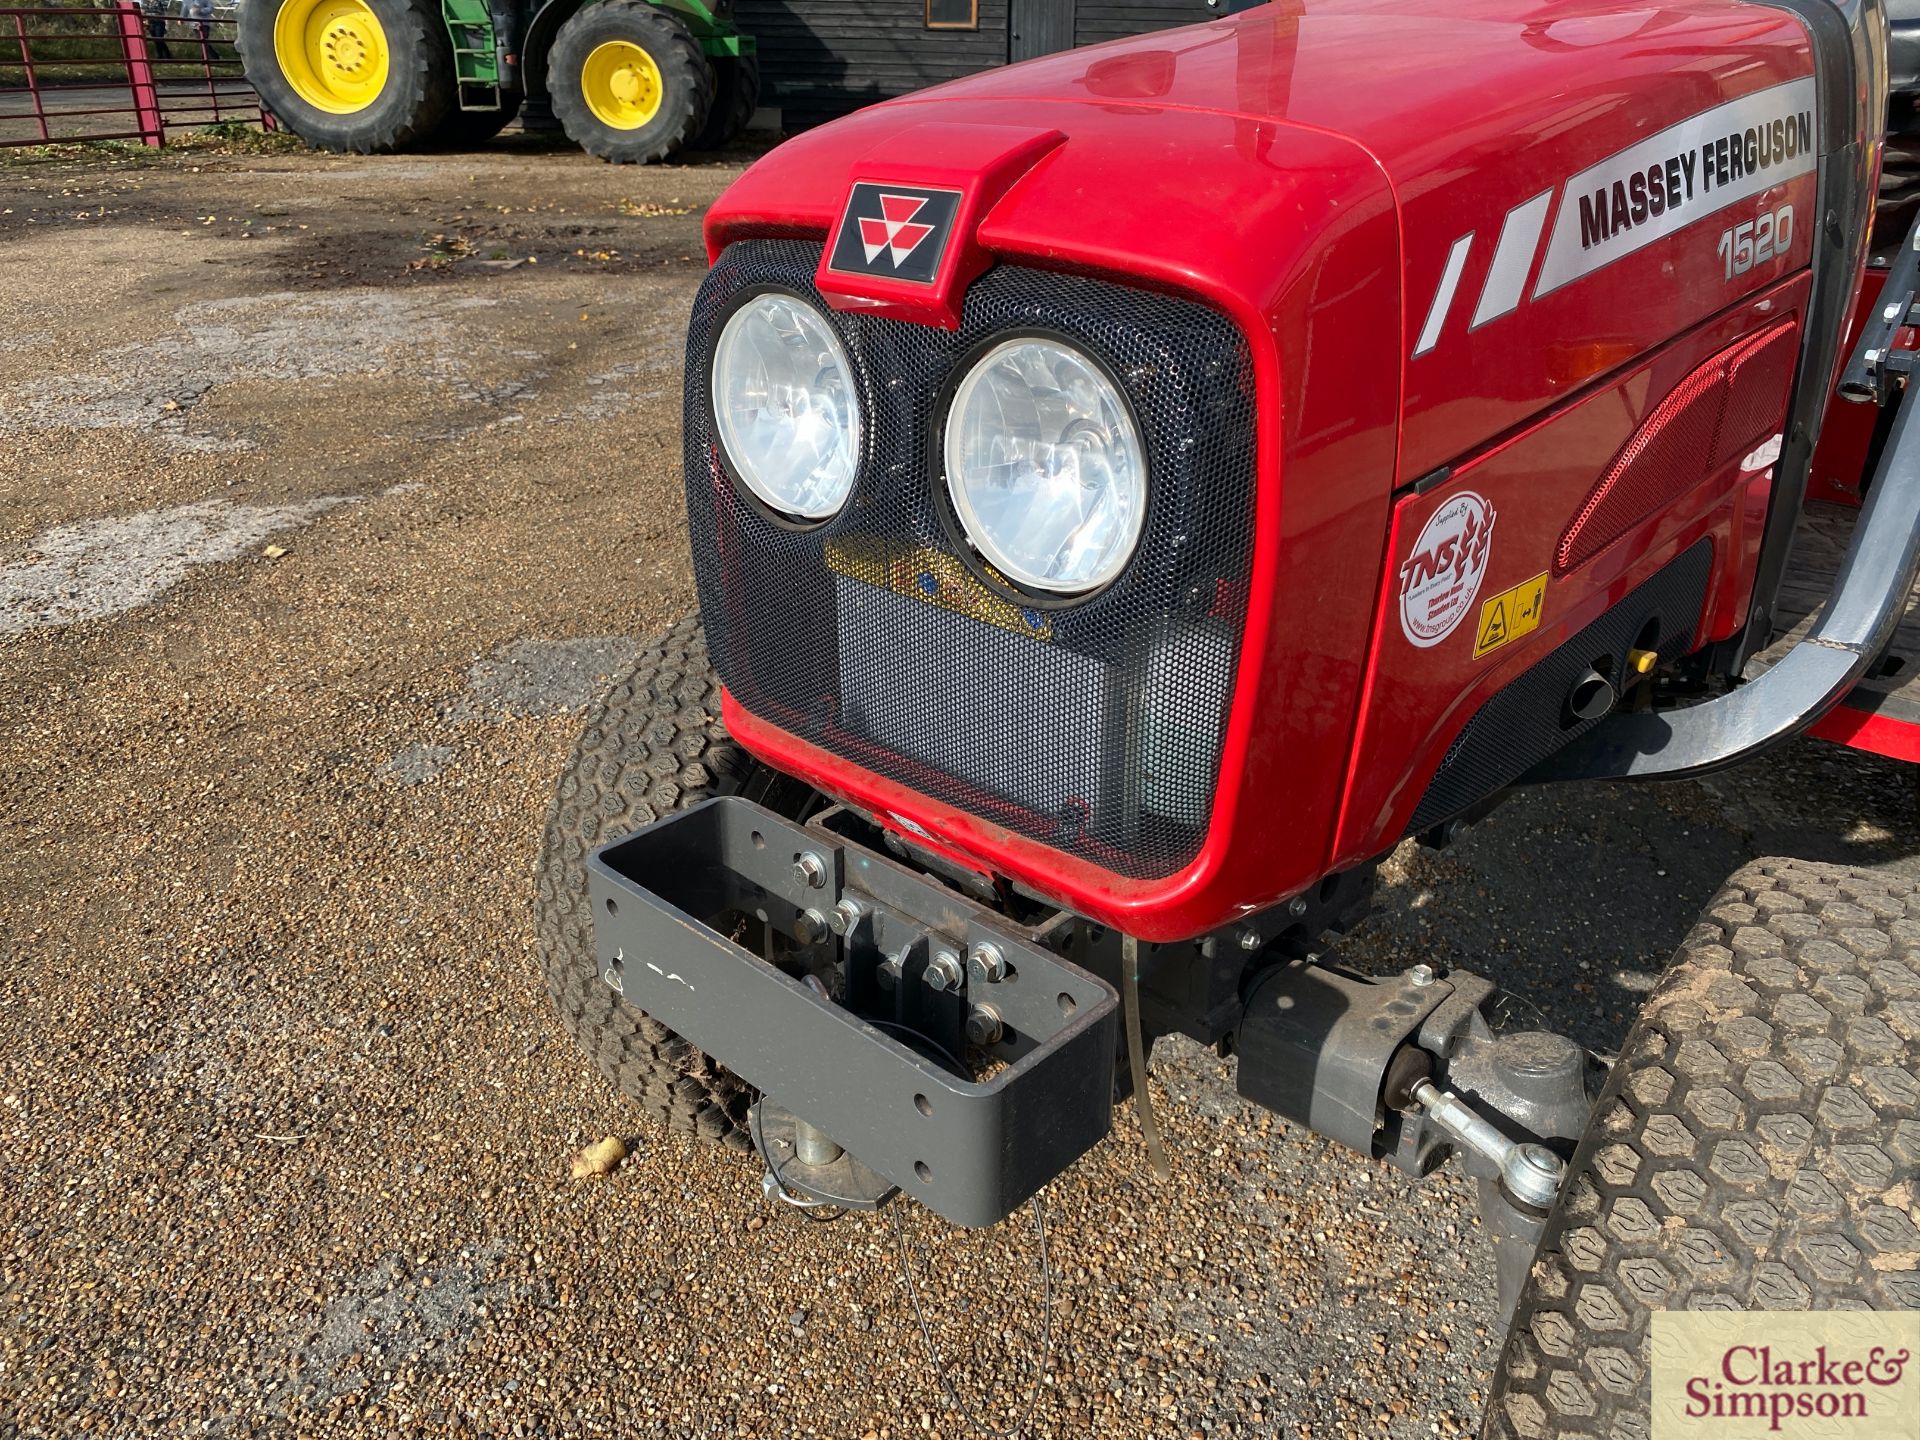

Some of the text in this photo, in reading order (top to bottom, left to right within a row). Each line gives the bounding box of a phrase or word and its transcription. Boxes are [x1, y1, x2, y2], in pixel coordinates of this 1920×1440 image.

[1579, 110, 1811, 250] MASSEY FERGUSON
[1716, 204, 1794, 281] 1520
[1436, 502, 1469, 527] Supplied By
[1402, 533, 1460, 595] TNS
[1412, 586, 1473, 634] www.tnsgroup.co.uk
[1428, 590, 1451, 610] Thurlow
[1428, 601, 1451, 621] Standen
